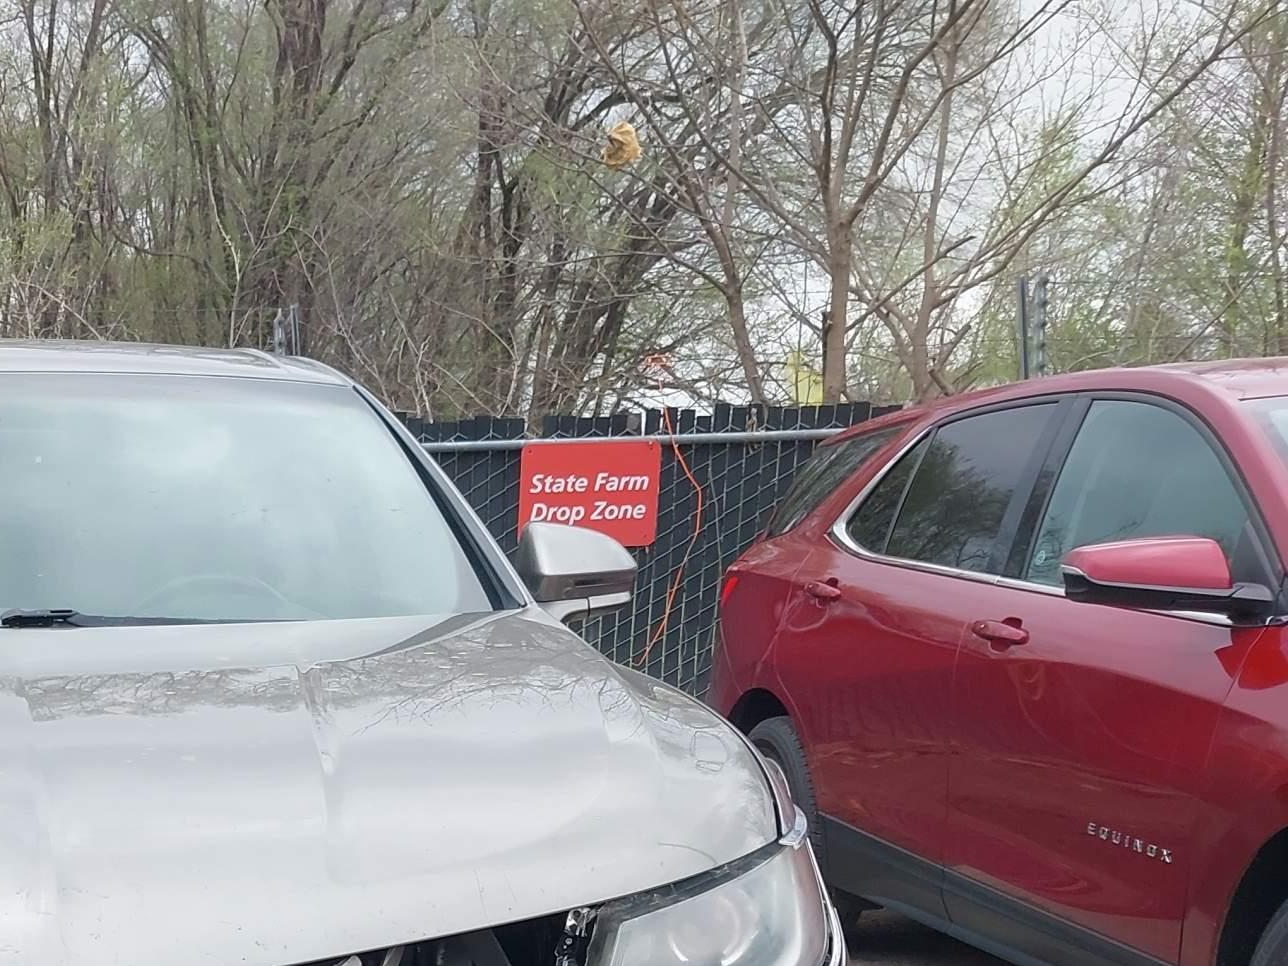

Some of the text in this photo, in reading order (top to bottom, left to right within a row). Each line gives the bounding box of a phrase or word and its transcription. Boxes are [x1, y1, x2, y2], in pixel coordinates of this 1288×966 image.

[529, 472, 649, 494] State Farm
[530, 501, 646, 525] Drop Zone
[1087, 822, 1172, 863] EQUINOX
